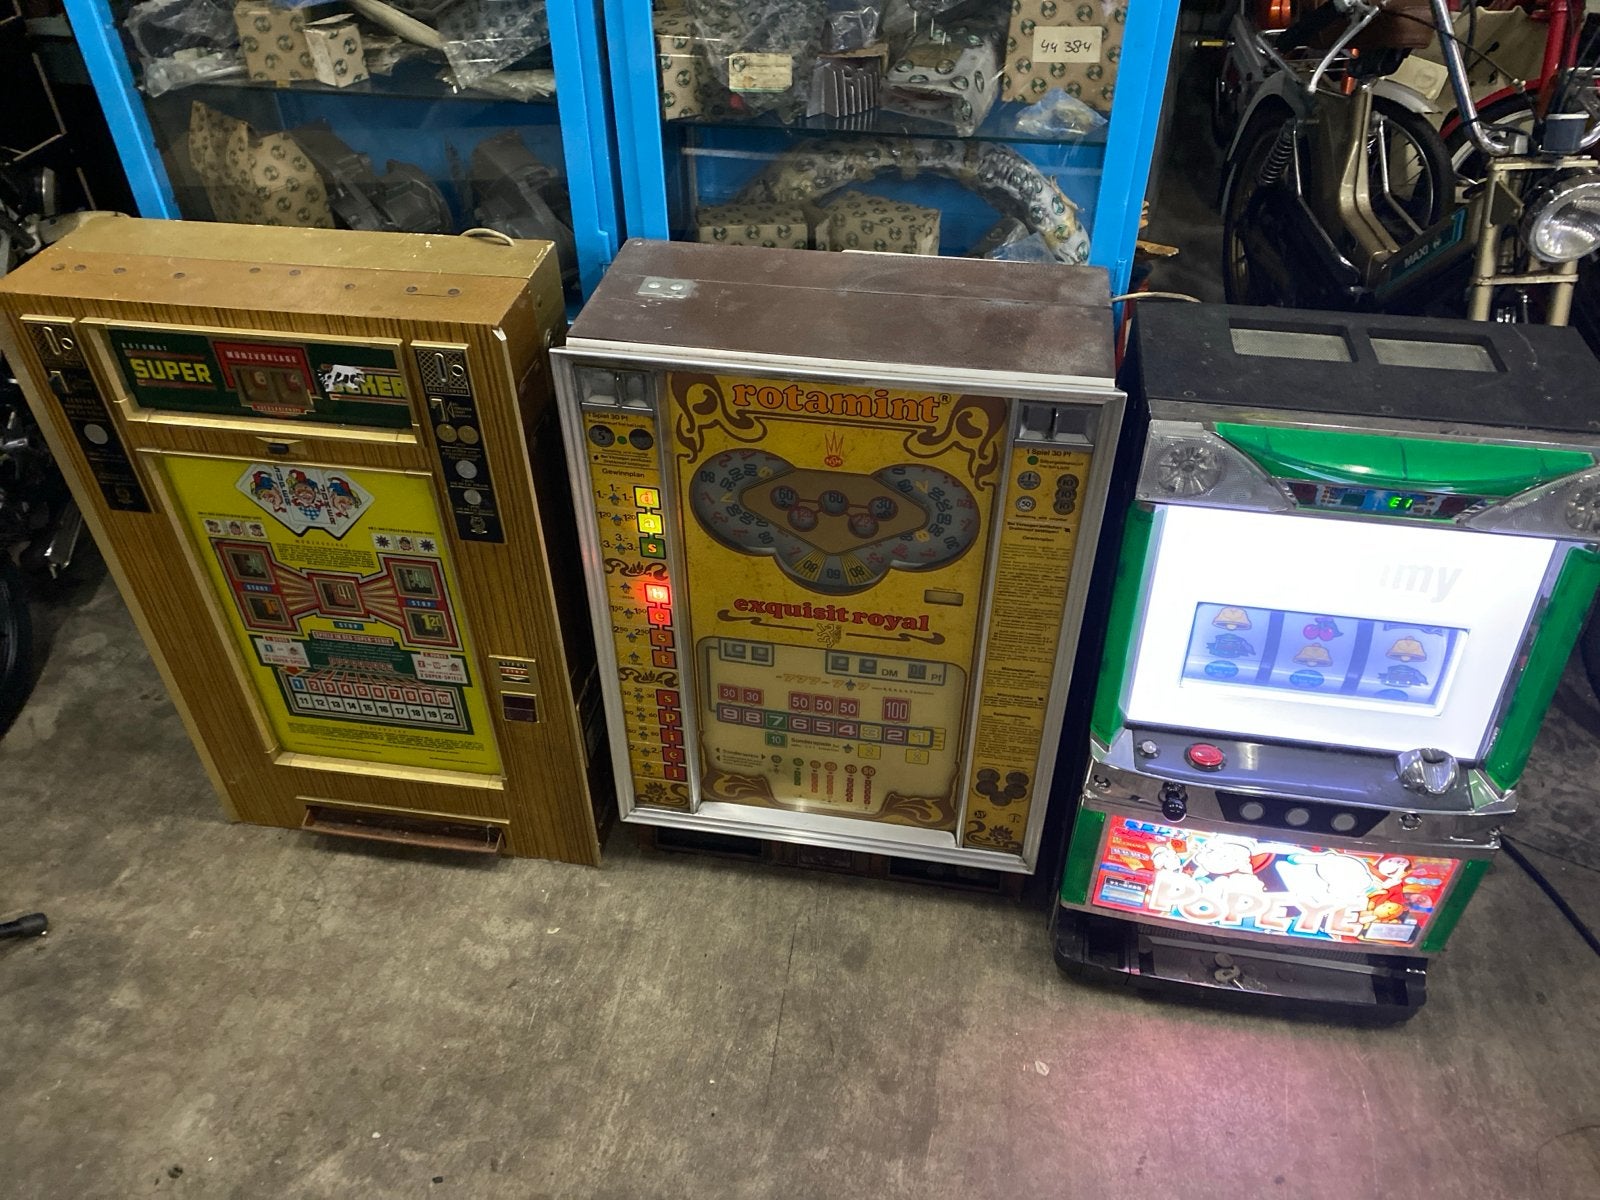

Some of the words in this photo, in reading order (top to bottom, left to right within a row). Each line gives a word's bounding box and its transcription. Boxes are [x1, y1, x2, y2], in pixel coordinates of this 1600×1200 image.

[1041, 39, 1058, 53] 44
[1064, 39, 1092, 53] 384
[1404, 244, 1429, 268] MAXI
[128, 358, 213, 383] SUPER
[602, 467, 645, 478] Gewinnplan
[733, 598, 849, 623] exquisit
[851, 610, 930, 632] royal
[881, 668, 898, 678] DM
[310, 682, 318, 691] 2
[326, 683, 334, 691] 3
[342, 685, 350, 693] 4
[359, 687, 366, 696] 5
[390, 690, 398, 699] 7
[439, 695, 450, 704] 10
[723, 687, 736, 698] 30
[746, 691, 759, 702] 30
[299, 697, 309, 705] 11
[314, 698, 326, 707] 12
[330, 700, 341, 708] 13
[347, 702, 358, 710] 14
[362, 704, 373, 712] 15
[379, 705, 389, 714] 16
[395, 707, 405, 715] 17
[411, 709, 421, 717] 18
[427, 710, 438, 719] 19
[443, 712, 455, 720] 20
[792, 697, 808, 708] 50
[816, 700, 832, 712] 50
[839, 703, 857, 714] 50
[885, 701, 908, 720] 100
[723, 708, 739, 720] 9
[745, 712, 761, 724] 8
[767, 715, 784, 726] 7
[792, 718, 808, 730] 6
[815, 721, 833, 733] 5
[839, 724, 856, 736] 4
[863, 727, 879, 739] 3
[887, 730, 903, 741] 2
[770, 736, 782, 745] 10
[1150, 875, 1364, 937] POPEYE
